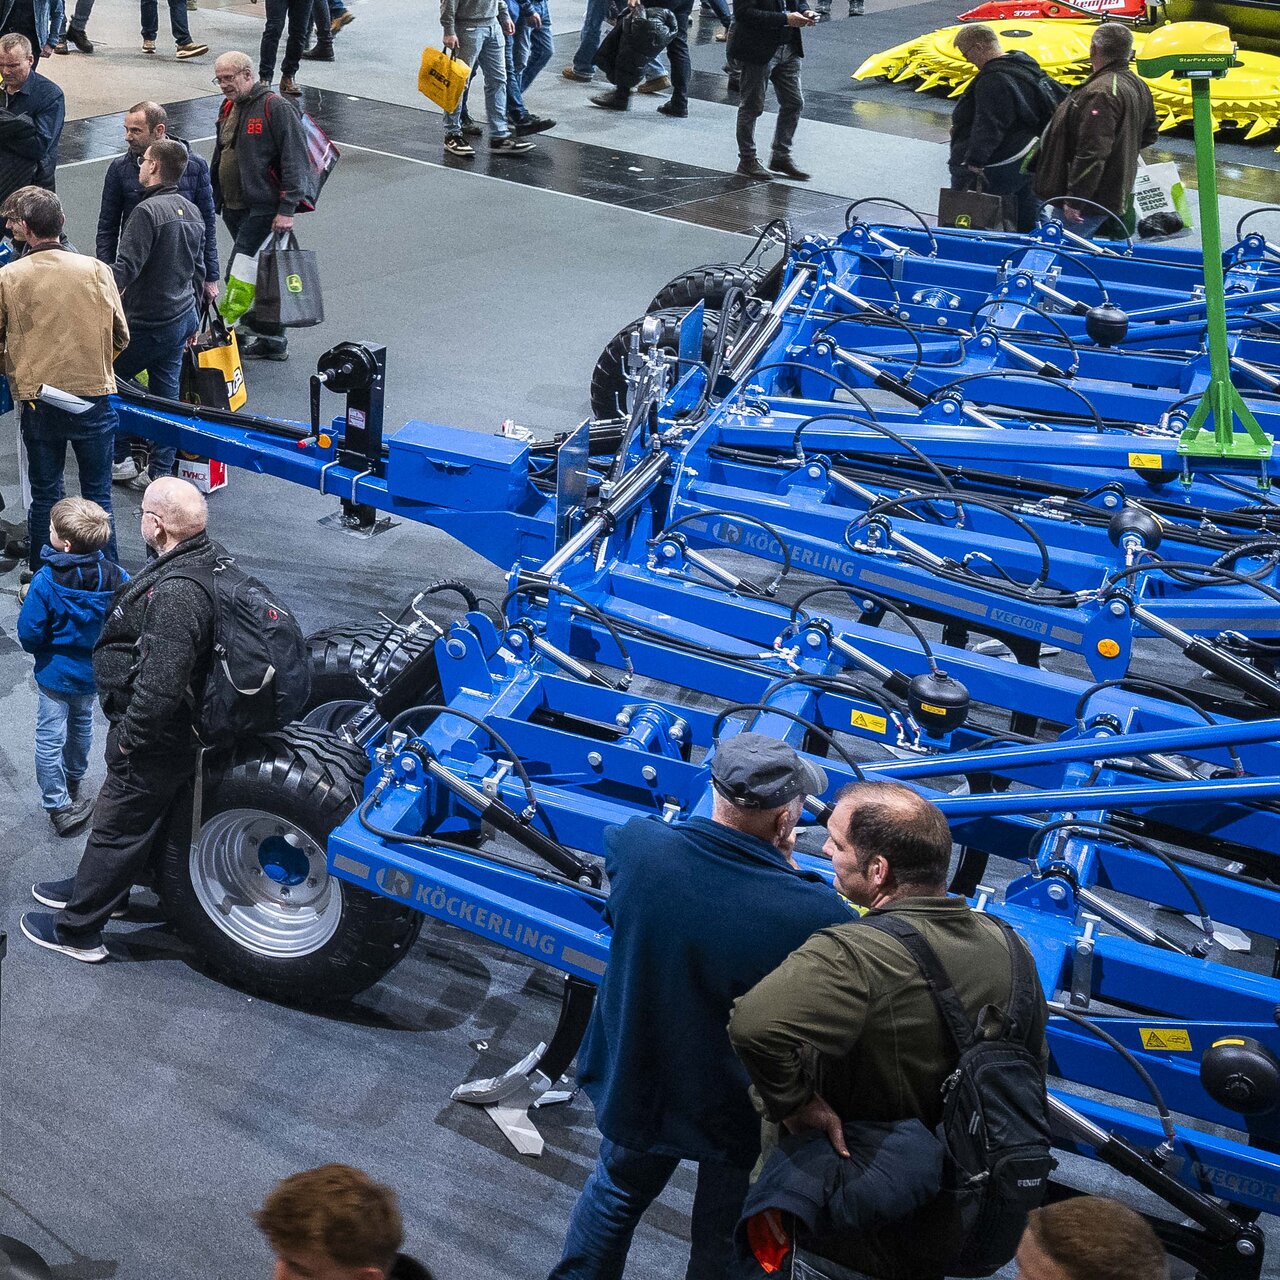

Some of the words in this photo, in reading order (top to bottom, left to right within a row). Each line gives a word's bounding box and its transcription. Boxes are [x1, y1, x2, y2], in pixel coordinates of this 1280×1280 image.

[1143, 187, 1161, 195] EVERY
[1136, 192, 1165, 202] GROUND
[1149, 197, 1166, 205] EVERY
[1141, 202, 1168, 212] SEASON
[995, 609, 1045, 633] VECTOR
[415, 883, 556, 956] KÖCKERLING
[1017, 1178, 1042, 1188] FENDT
